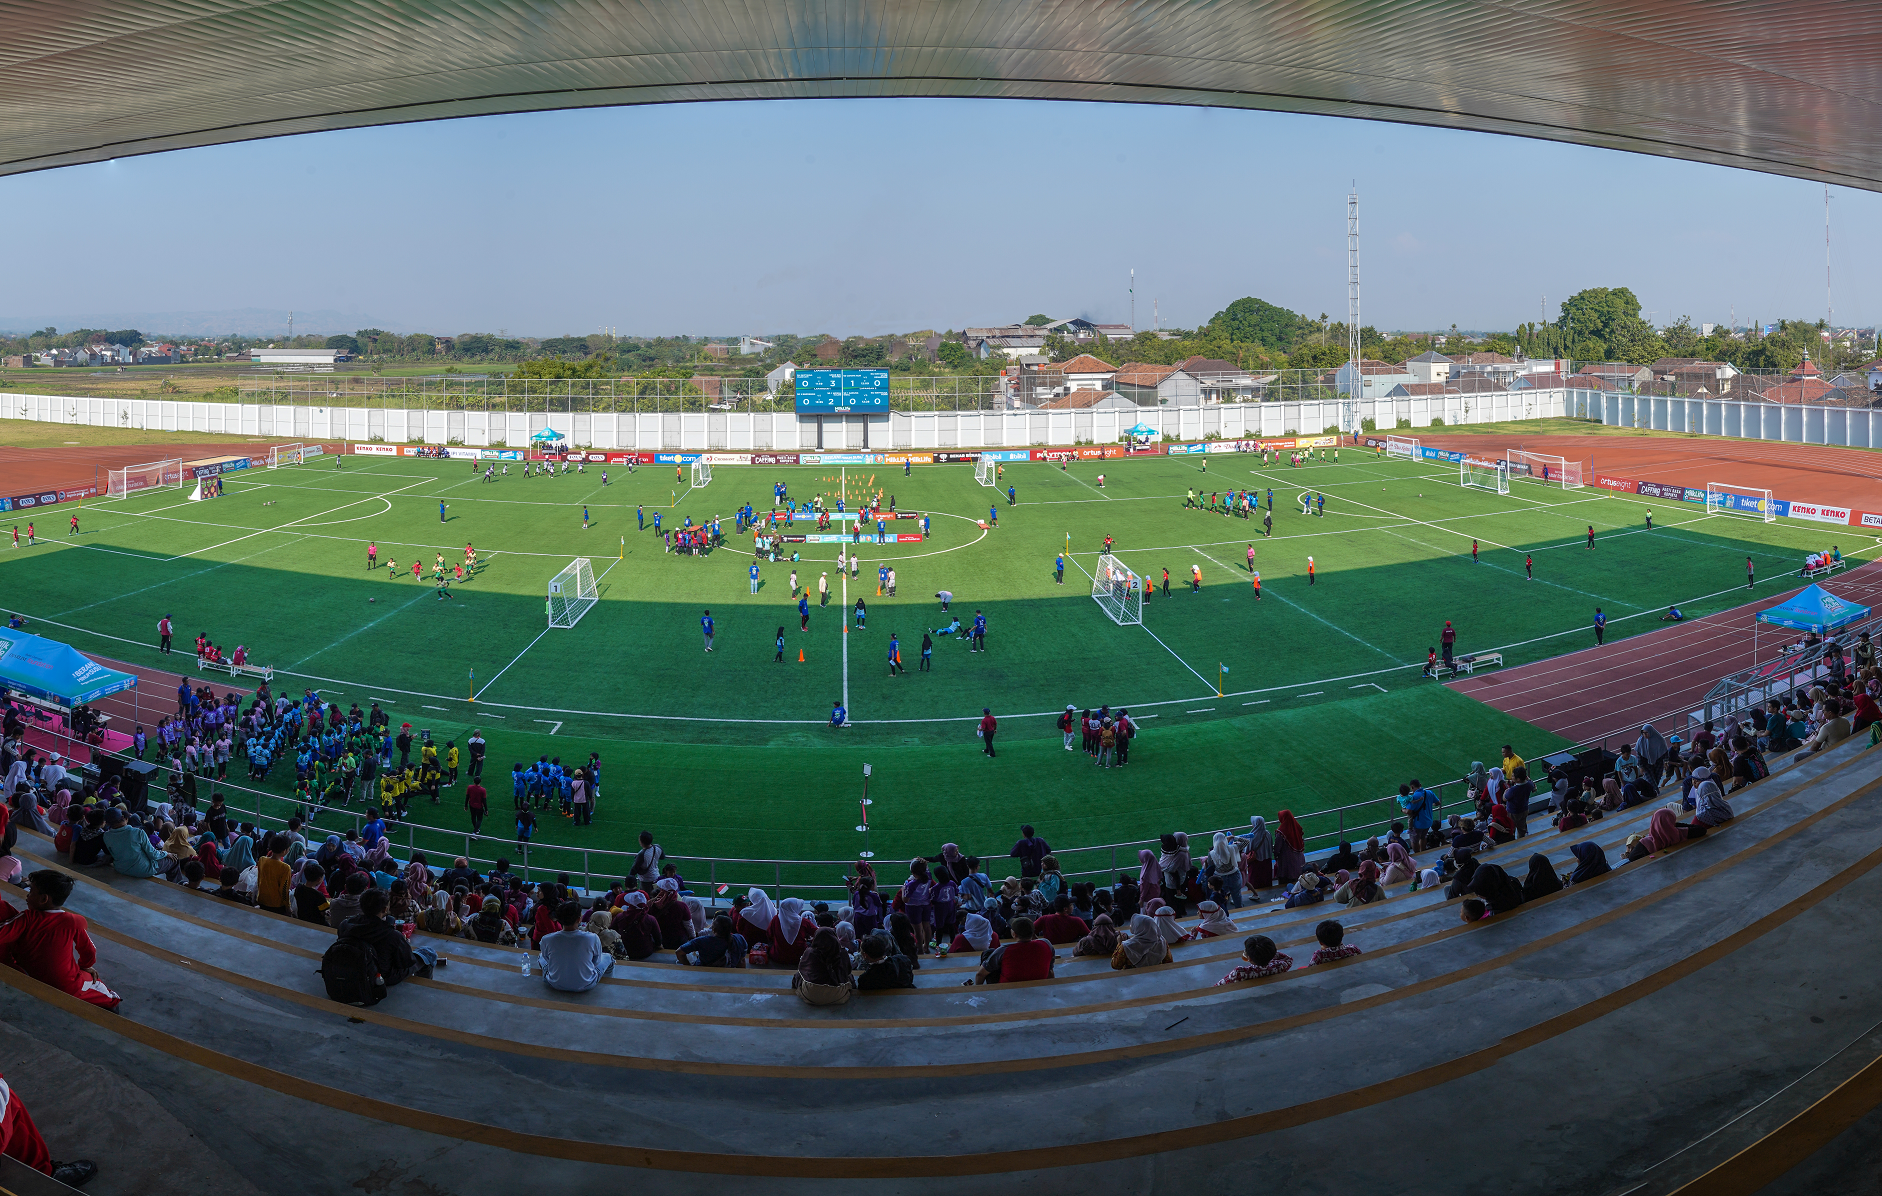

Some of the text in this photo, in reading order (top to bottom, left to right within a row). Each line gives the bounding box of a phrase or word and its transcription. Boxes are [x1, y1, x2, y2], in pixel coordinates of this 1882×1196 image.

[1601, 478, 1631, 490] ortuseight
[1641, 486, 1660, 496] CAFFINO
[1792, 505, 1846, 518] KENKO KENKO
[1864, 516, 1882, 525] BETA
[27, 658, 53, 669] foundation
